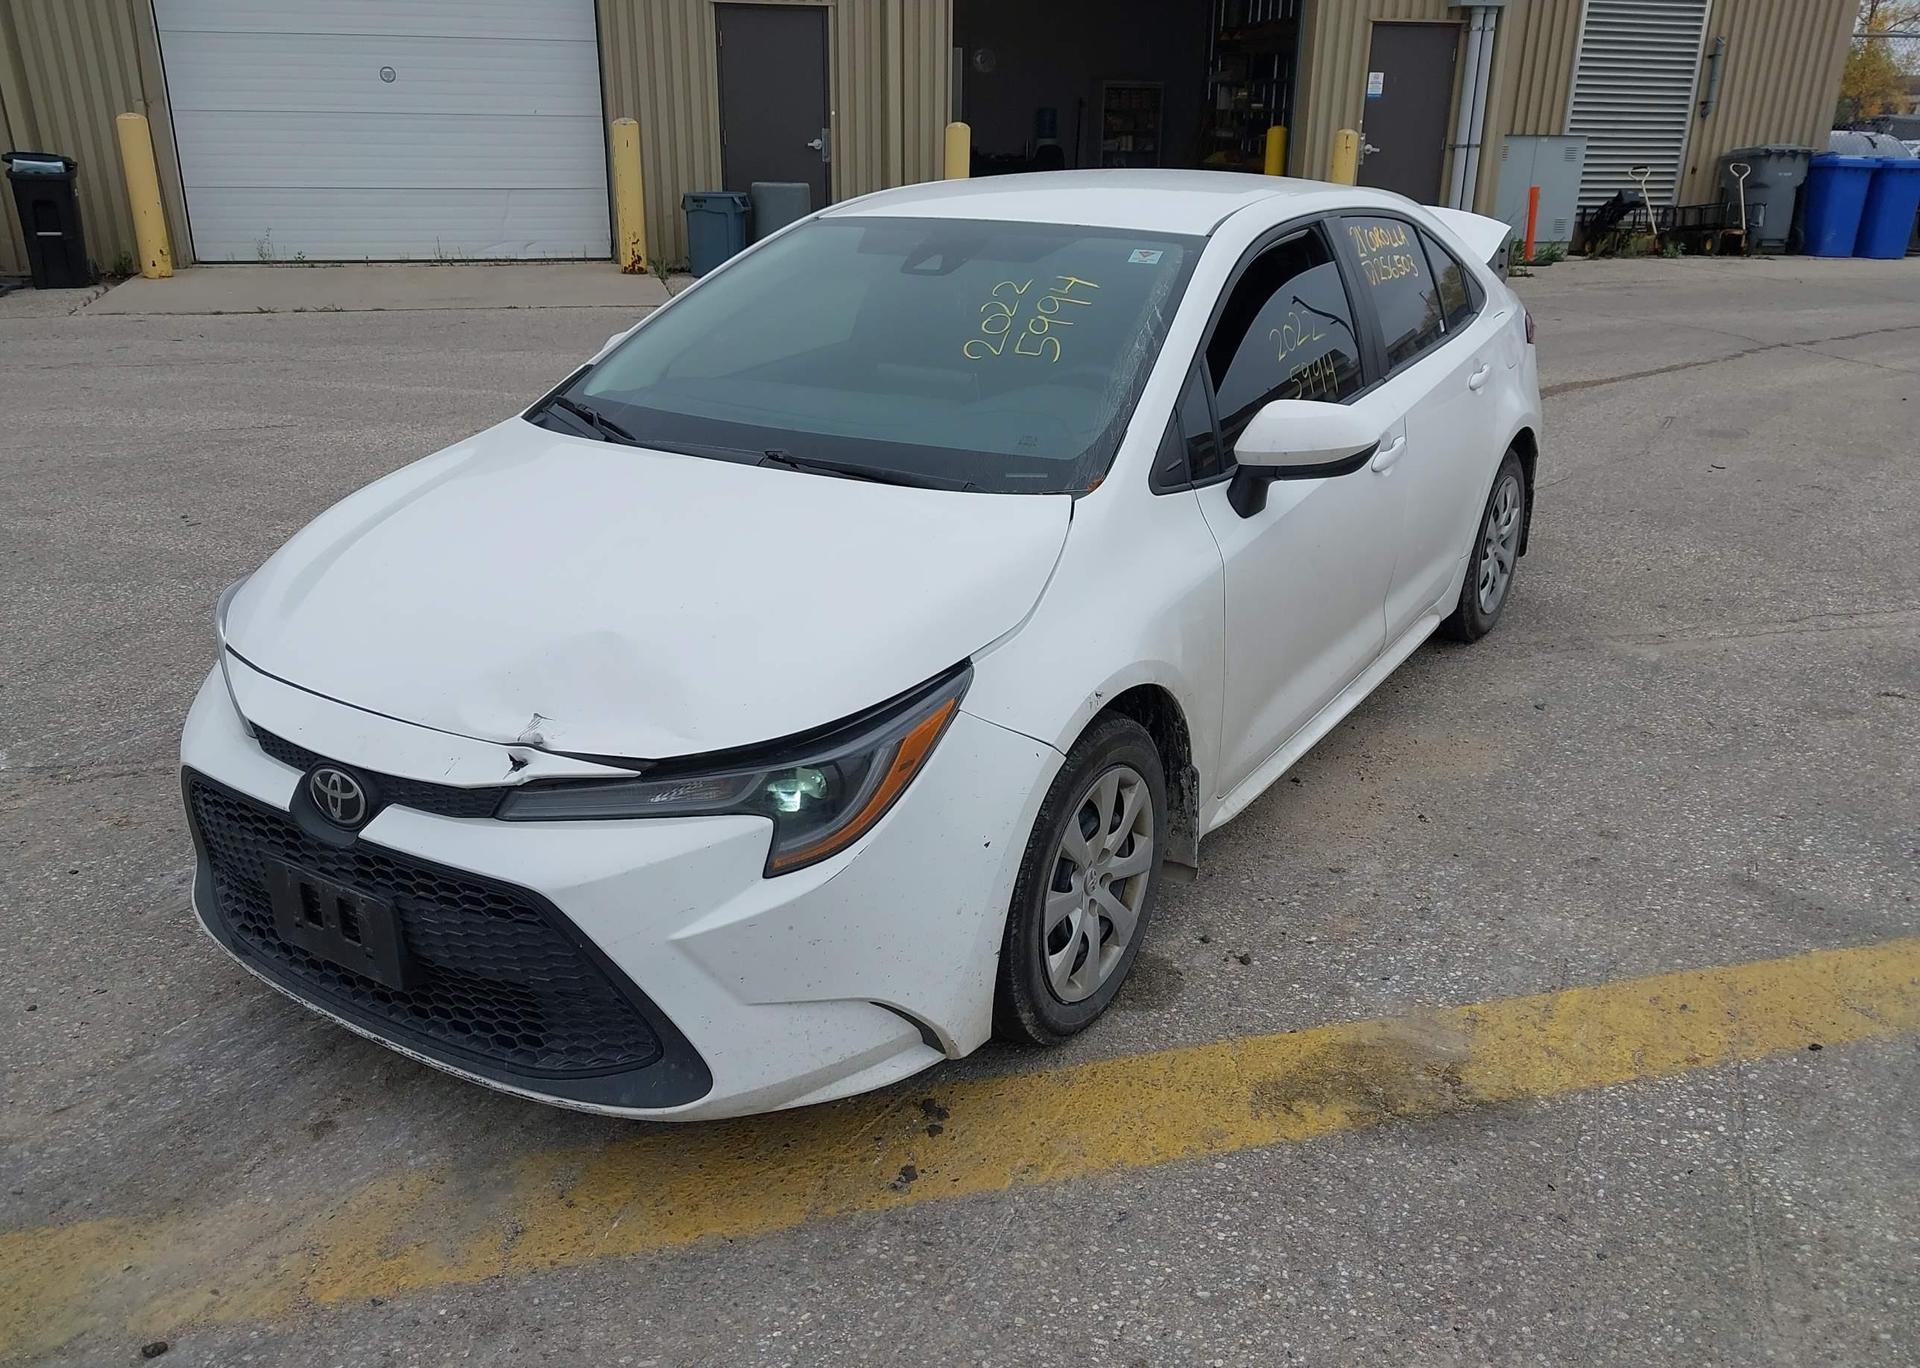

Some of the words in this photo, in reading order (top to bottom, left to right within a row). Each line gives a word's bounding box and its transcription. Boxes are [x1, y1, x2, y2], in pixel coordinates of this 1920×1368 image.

[963, 278, 1034, 360] 2022
[1014, 275, 1101, 363] 5994
[1268, 310, 1327, 362] 2022
[1289, 352, 1339, 400] 5994
